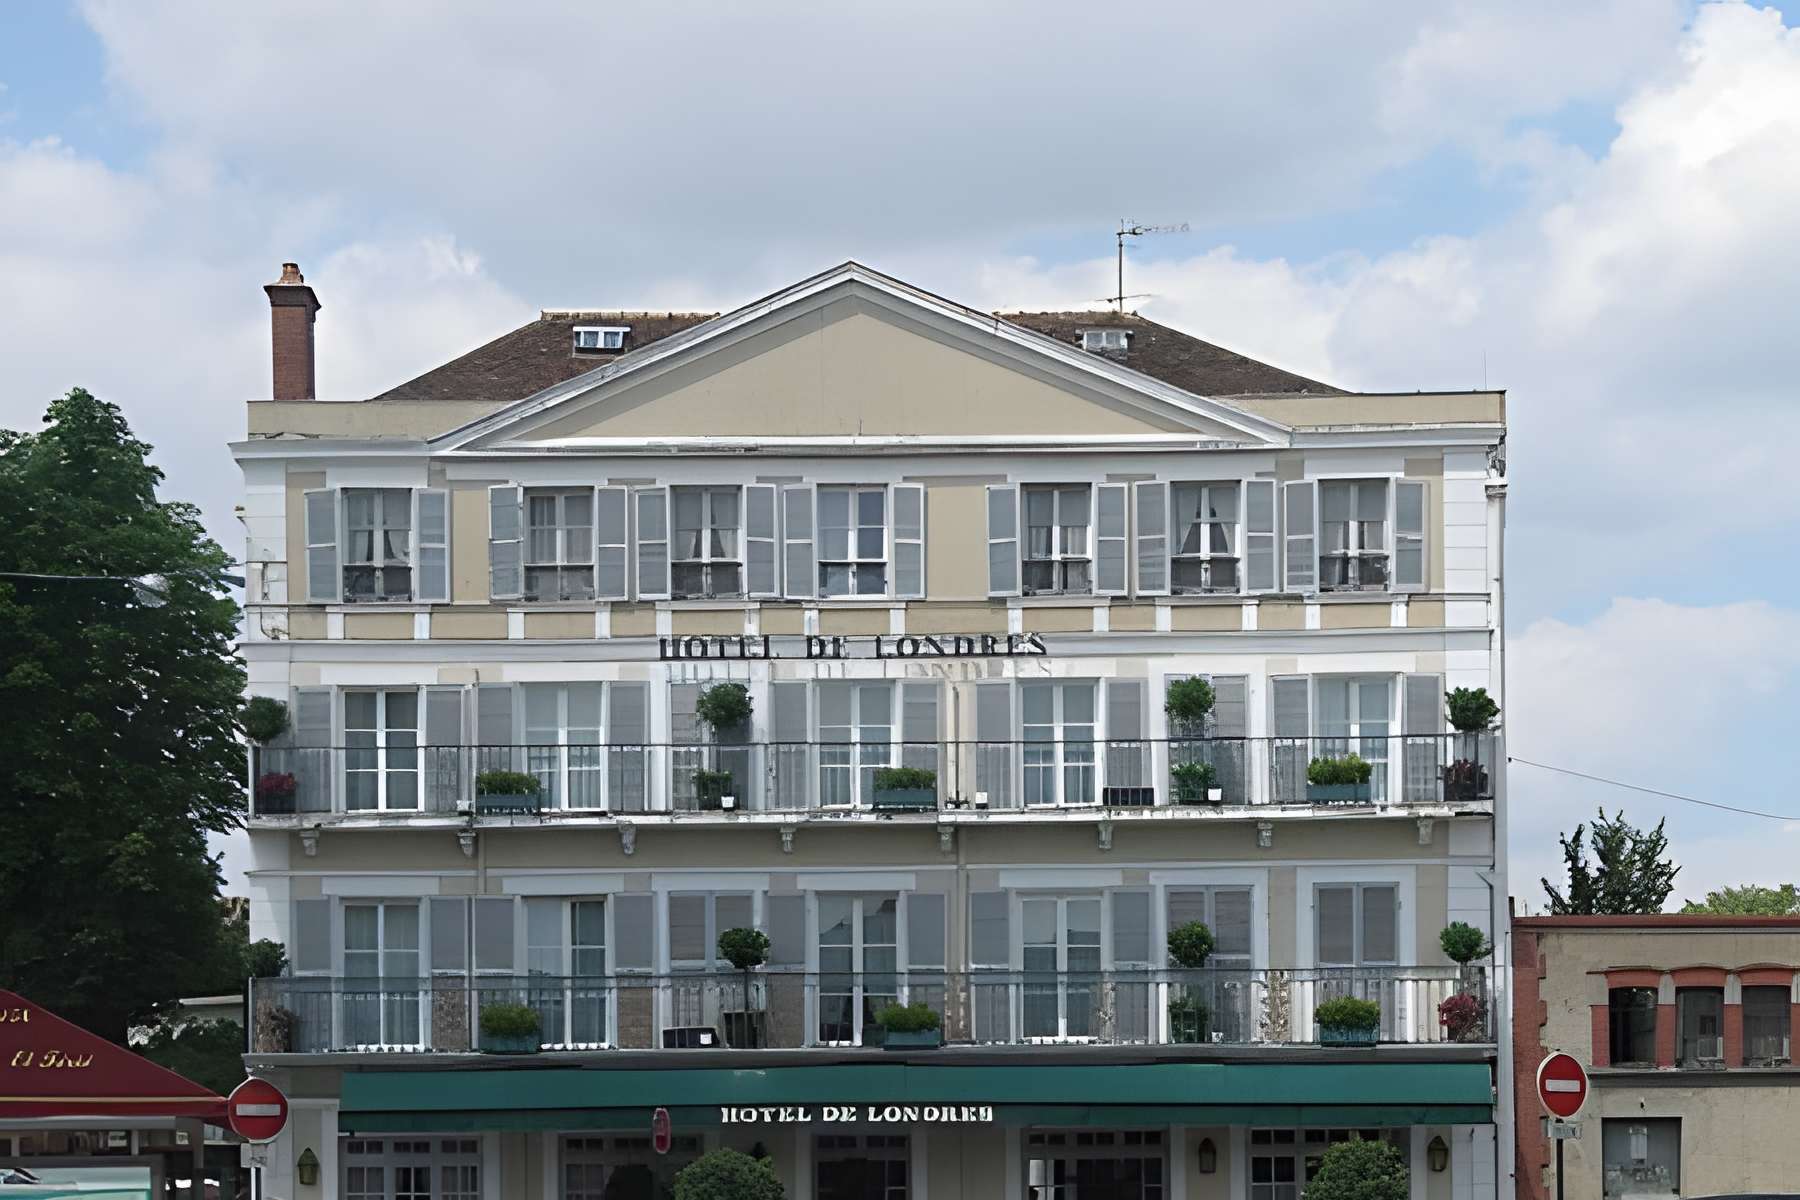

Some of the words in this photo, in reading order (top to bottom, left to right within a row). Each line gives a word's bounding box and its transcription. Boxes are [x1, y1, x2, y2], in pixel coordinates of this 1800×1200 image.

[876, 631, 1047, 658] LONDRES
[720, 1106, 812, 1123] HOTEL
[822, 1106, 857, 1122] DE
